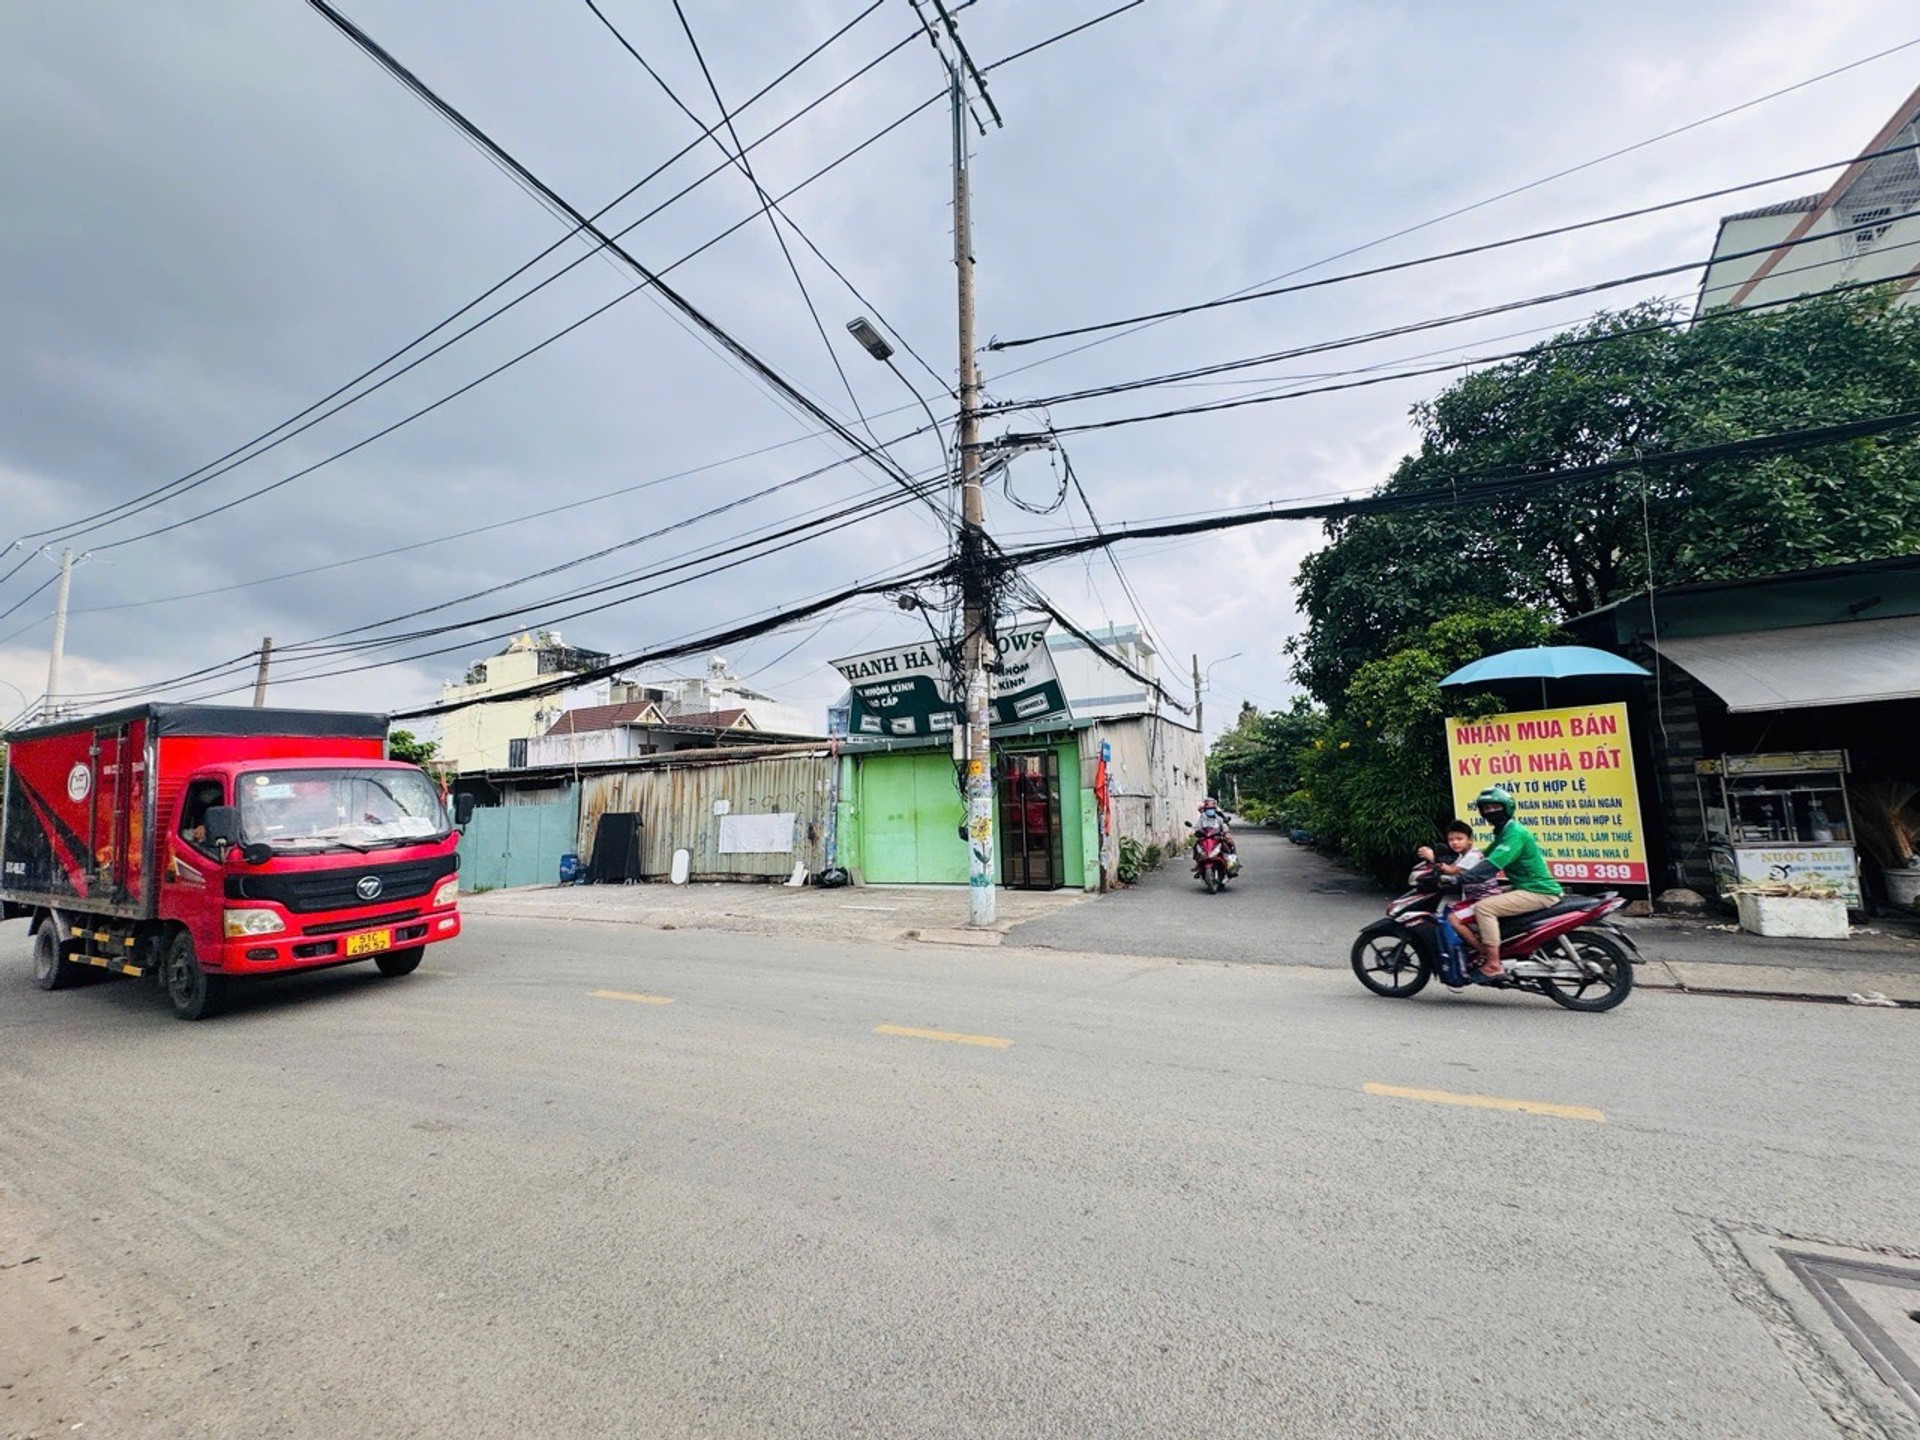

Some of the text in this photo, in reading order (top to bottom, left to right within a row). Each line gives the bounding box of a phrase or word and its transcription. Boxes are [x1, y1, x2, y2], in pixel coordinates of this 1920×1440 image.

[902, 646, 933, 669] HÀ
[1456, 713, 1617, 747] NHẬN MUA BÁN
[1458, 742, 1621, 776] KÝ GỬI NHÀ ĐẤT
[1524, 779, 1539, 793] TỜ
[1543, 779, 1567, 794] HỢP
[1572, 777, 1587, 793] LỆ
[1566, 797, 1577, 809] VÀ
[1553, 864, 1631, 879] 899 389
